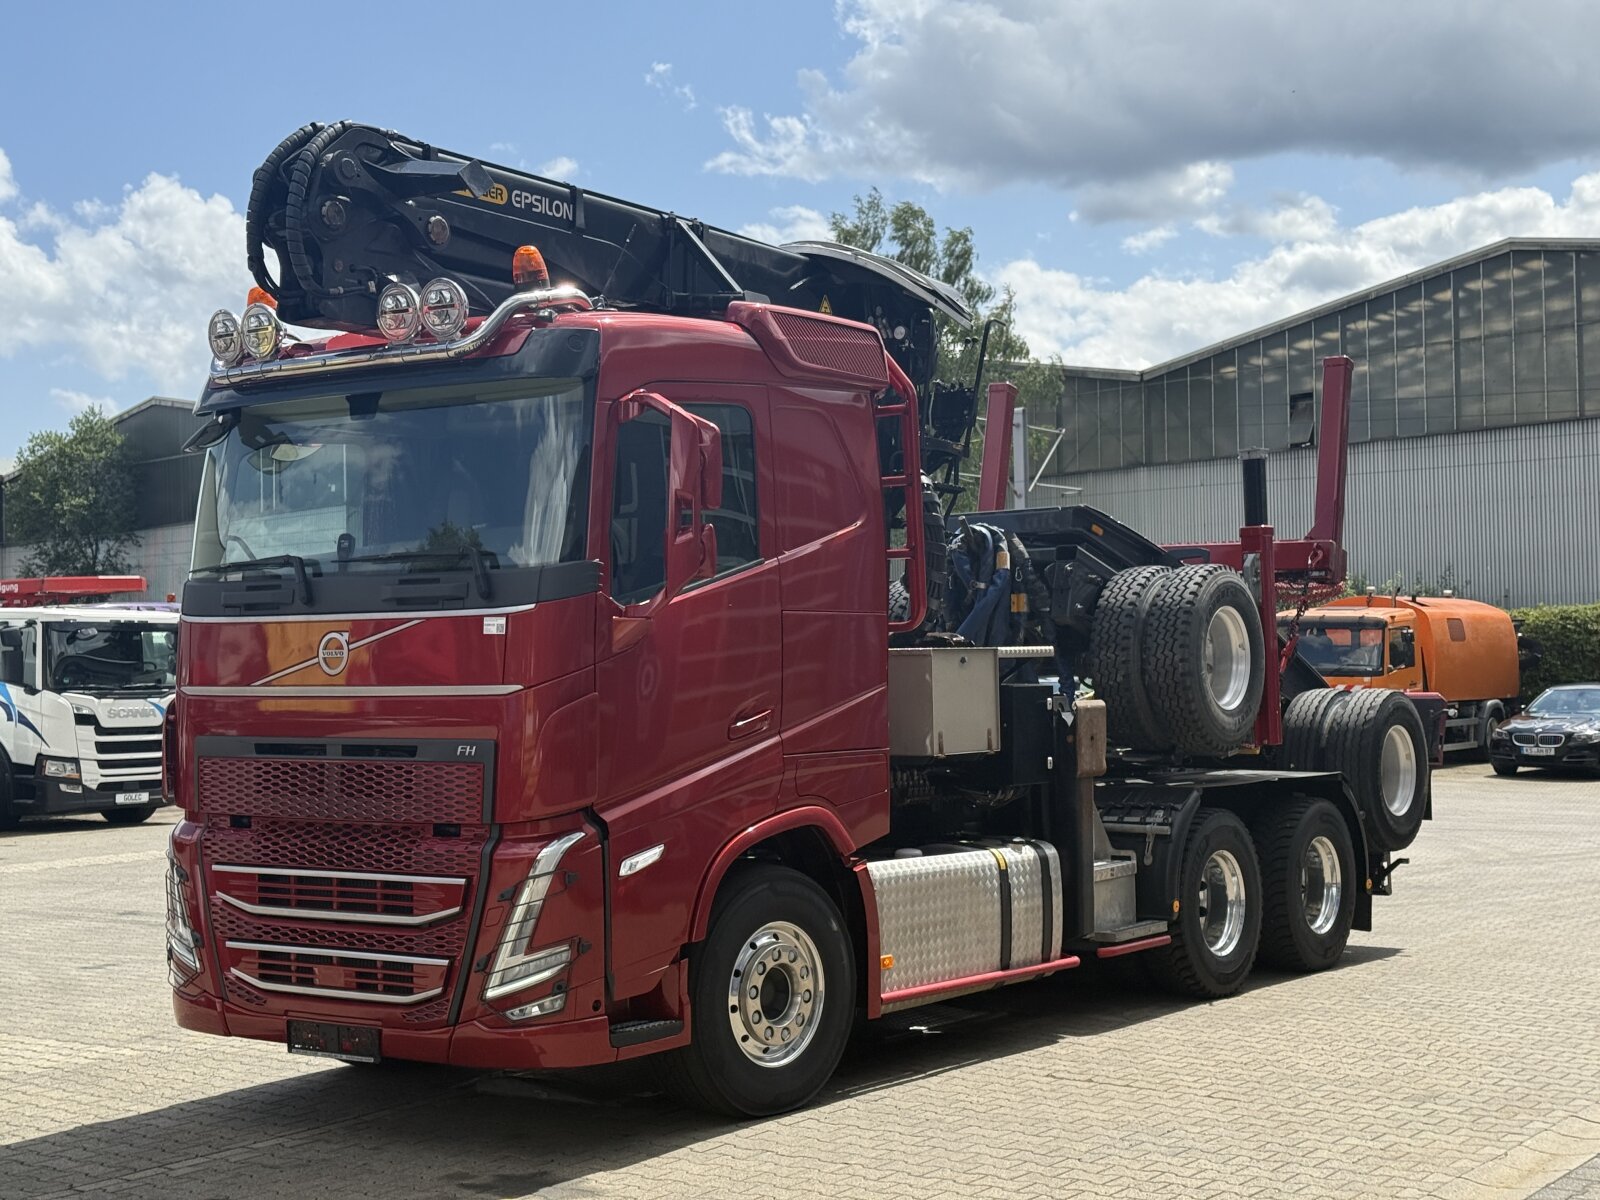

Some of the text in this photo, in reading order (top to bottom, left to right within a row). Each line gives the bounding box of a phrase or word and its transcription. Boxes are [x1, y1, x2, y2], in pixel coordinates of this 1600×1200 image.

[511, 189, 573, 221] EPSILON
[107, 707, 157, 719] SCANIA
[457, 745, 476, 756] FH
